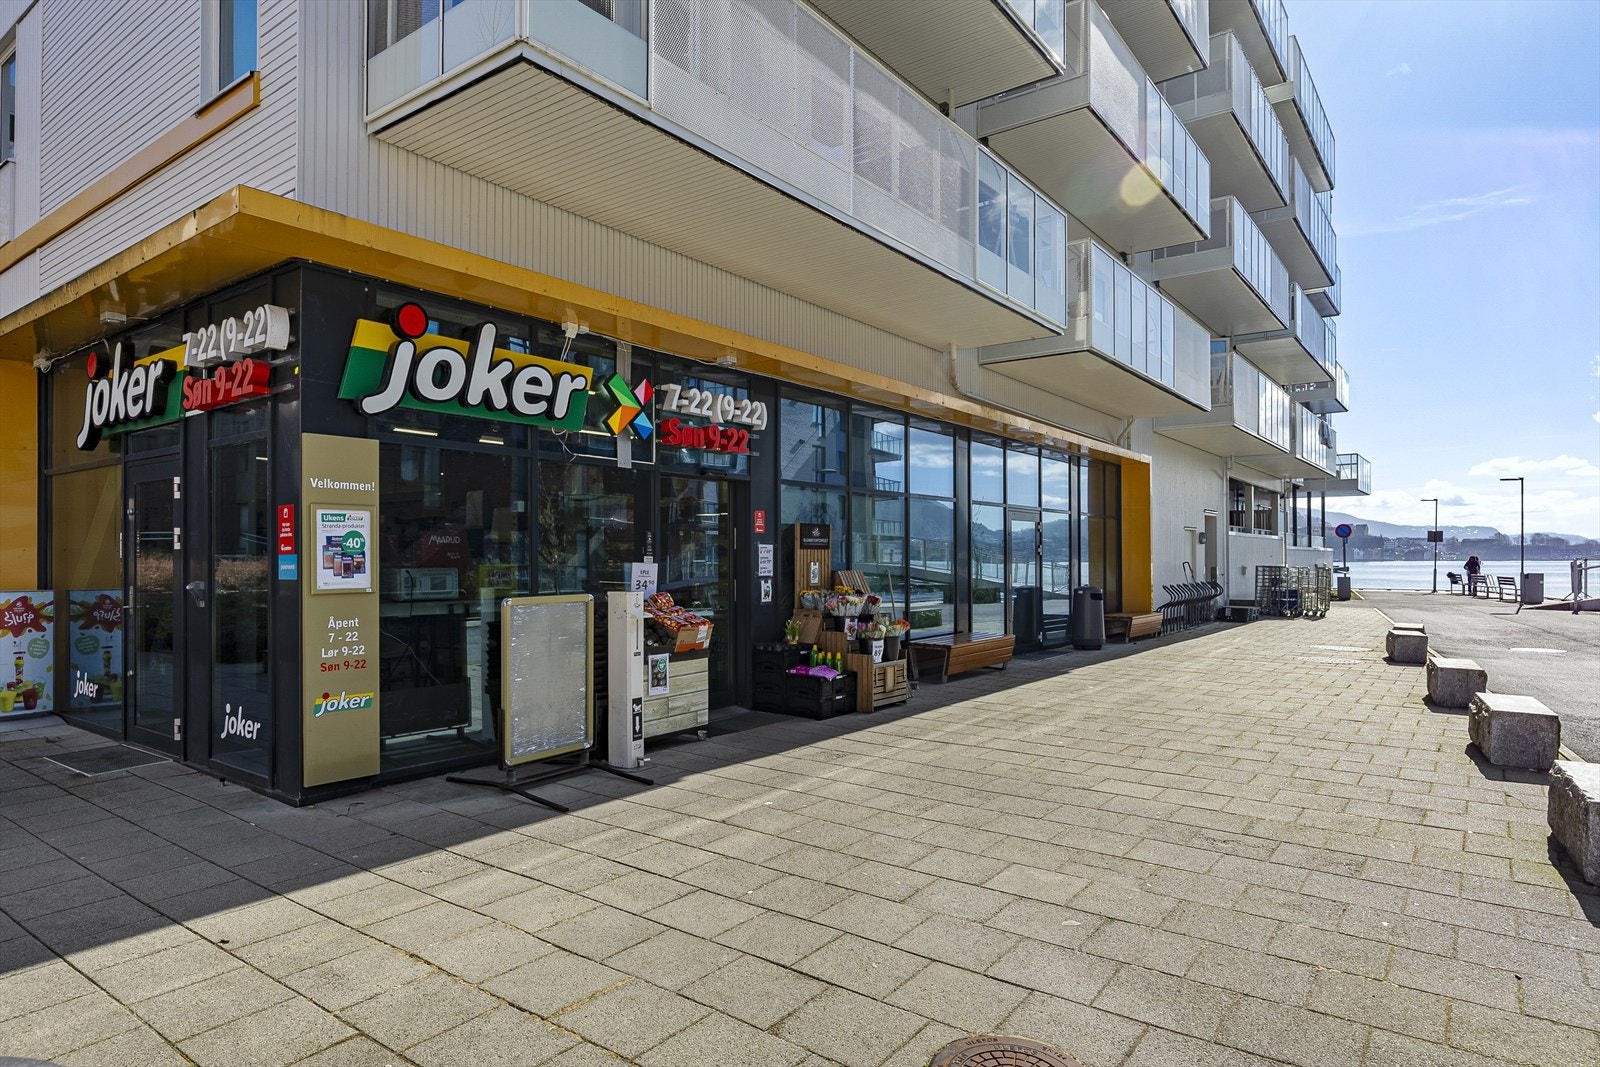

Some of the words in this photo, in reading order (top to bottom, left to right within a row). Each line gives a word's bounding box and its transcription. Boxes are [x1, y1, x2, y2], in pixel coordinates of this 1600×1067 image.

[182, 324, 216, 366] 7-22
[220, 304, 272, 361] (9-22)
[358, 302, 588, 420] joker
[76, 342, 165, 449] joker
[183, 375, 211, 410] Søn
[215, 358, 253, 402] 9-22
[662, 383, 713, 417] 7-22
[714, 393, 768, 431] (9-22)
[665, 417, 705, 448] Søn
[708, 423, 750, 454] 9-22
[310, 477, 375, 491] Velkommen!
[429, 535, 461, 545] MAARUD
[635, 579, 648, 590] 34
[327, 616, 359, 630] Åpent
[321, 646, 339, 658] Lør
[341, 645, 365, 657] 9-22
[320, 661, 341, 673] Søn
[343, 659, 367, 672] 9-22
[73, 670, 99, 698] joker
[314, 690, 370, 718] joker
[220, 703, 261, 740] joker
